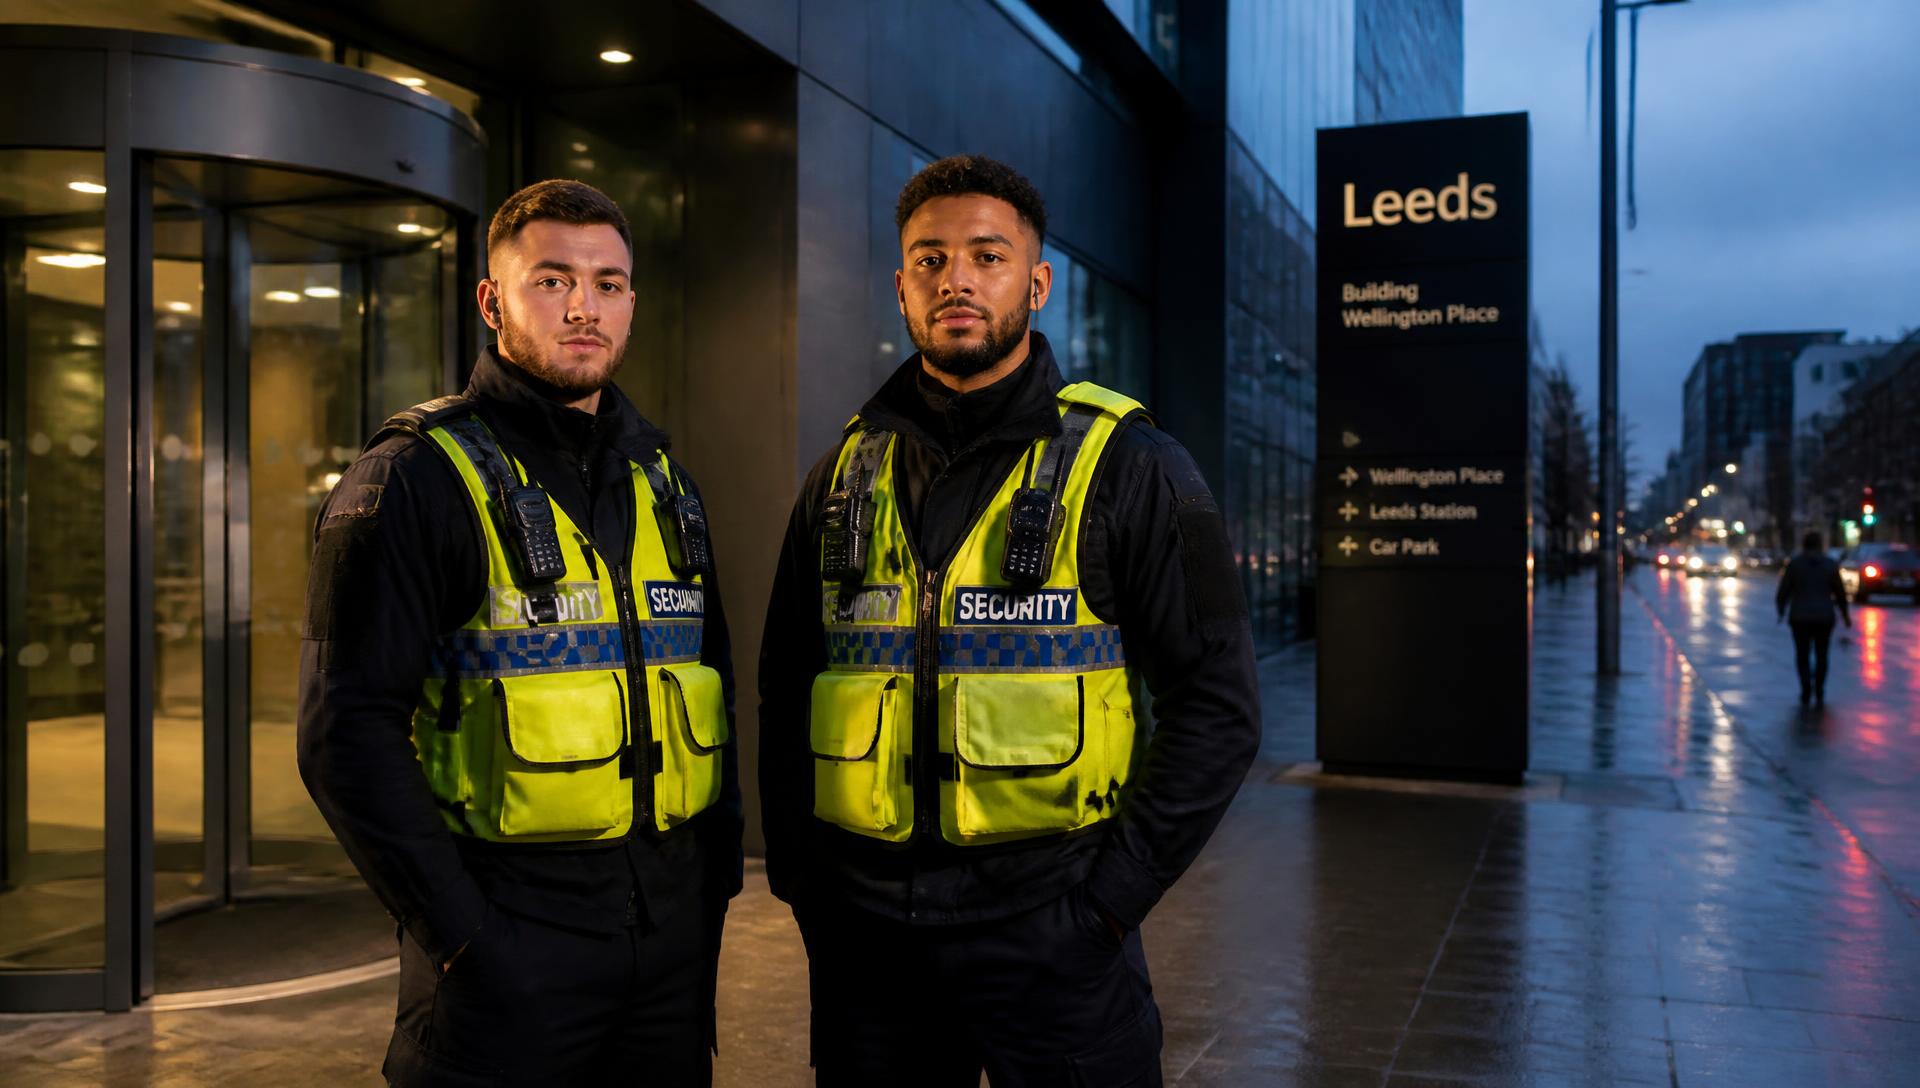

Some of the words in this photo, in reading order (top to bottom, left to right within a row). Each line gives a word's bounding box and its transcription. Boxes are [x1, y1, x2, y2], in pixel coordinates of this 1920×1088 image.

[1343, 171, 1498, 229] Leeds
[1342, 281, 1419, 304] Building
[1342, 307, 1443, 330] Wellington
[1447, 304, 1499, 324] Place
[1369, 467, 1457, 489] Wellington
[1460, 466, 1504, 485] Place
[1369, 502, 1417, 521] Leeds
[1420, 502, 1478, 521] Station
[1369, 537, 1399, 556] Car
[1402, 537, 1440, 556] Park
[959, 592, 1073, 621] SECURITY
